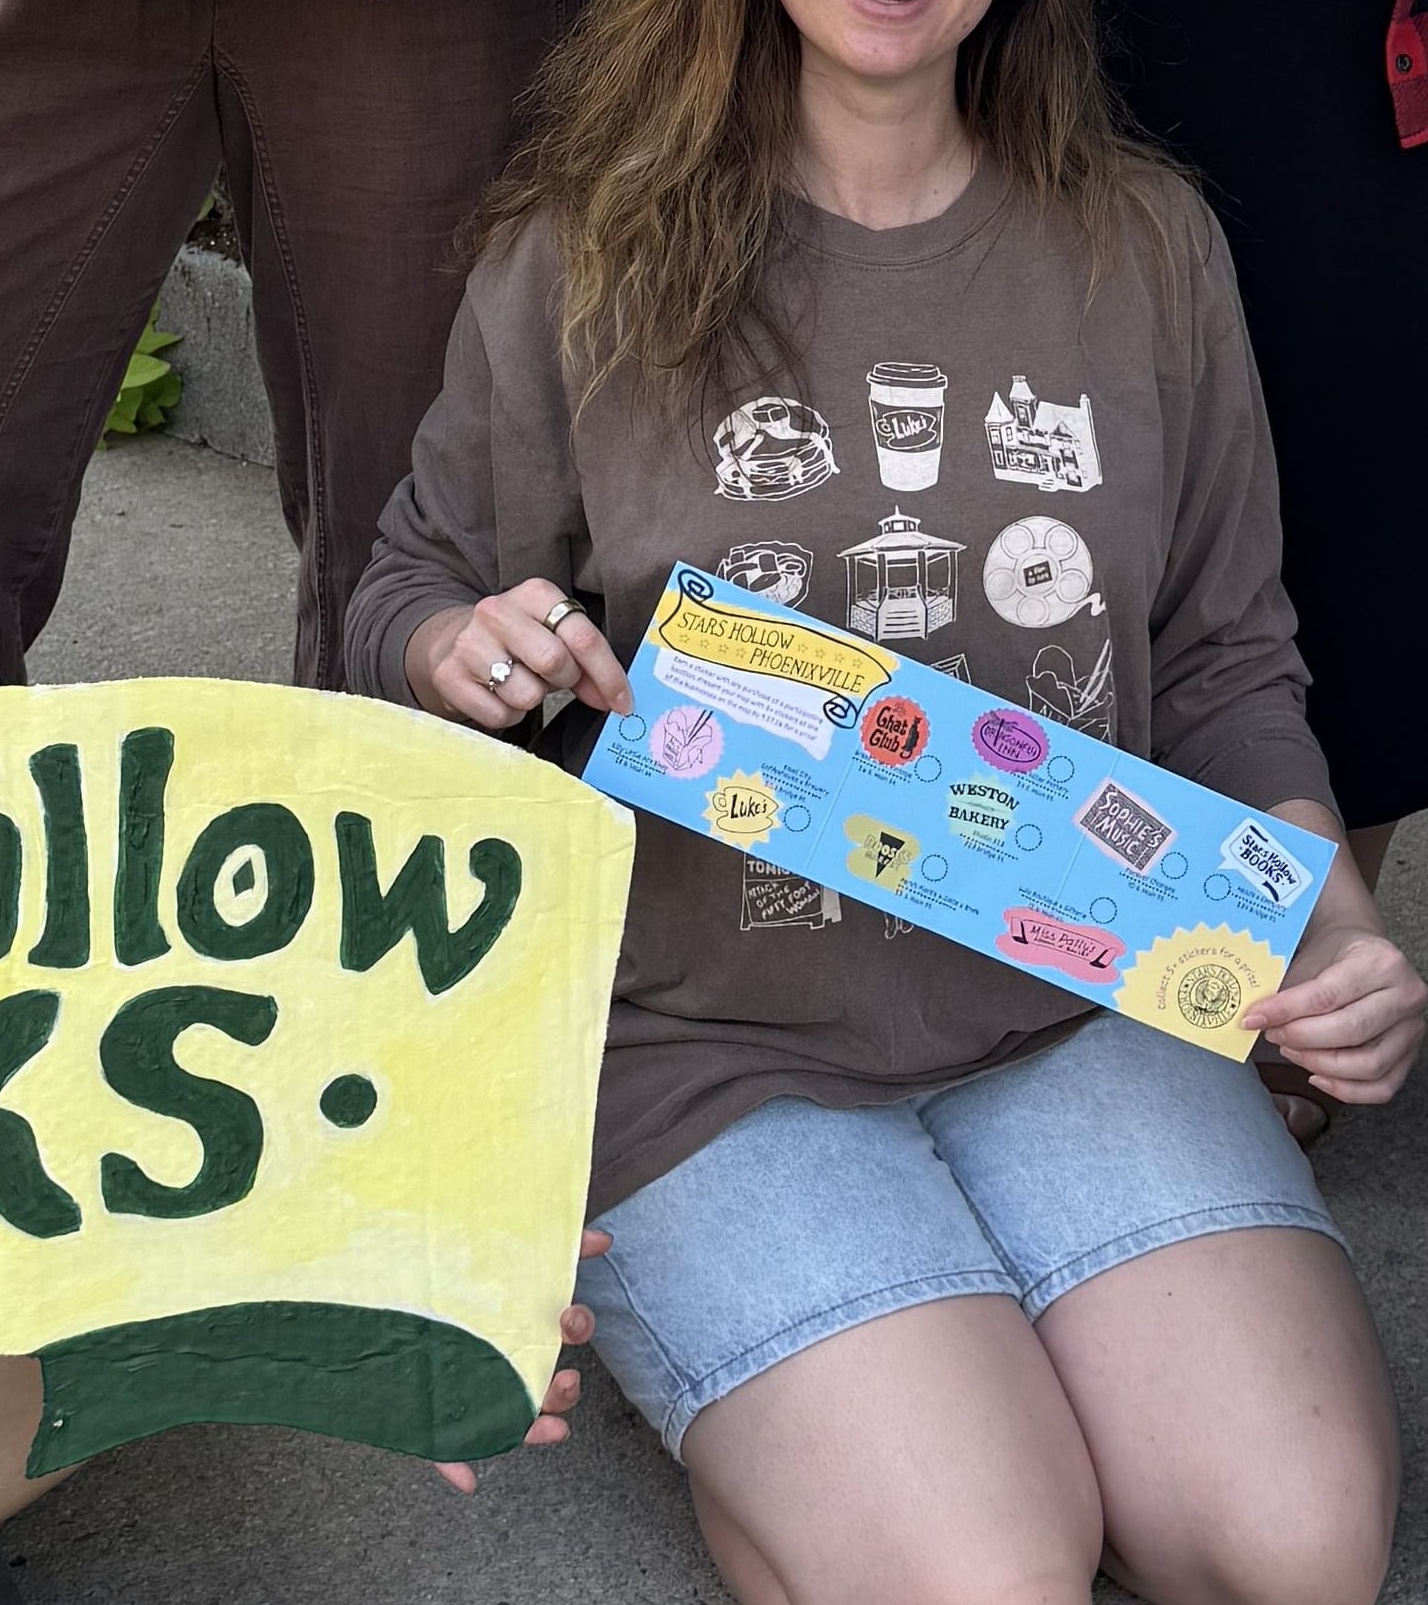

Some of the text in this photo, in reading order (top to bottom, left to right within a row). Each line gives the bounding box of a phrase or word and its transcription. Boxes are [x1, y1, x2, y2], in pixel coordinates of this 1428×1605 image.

[892, 414, 929, 441] Luke's
[677, 611, 794, 650] STARS HOLLOW
[749, 648, 865, 694] PHOENIXVILLE
[997, 743, 1022, 760] INN
[730, 793, 768, 819] Luke's
[949, 783, 1020, 811] WESTON
[948, 806, 1011, 831] BAKERY
[1098, 789, 1164, 848] SOPHIE'S
[1094, 812, 1140, 856] MUSIC
[1242, 834, 1270, 859] Stars
[1239, 846, 1284, 884] BOOKS
[788, 881, 812, 903] FOOT
[1029, 925, 1056, 942] Miss
[1058, 931, 1097, 953] Patty's
[1178, 948, 1218, 967] stickers
[1219, 947, 1235, 959] for
